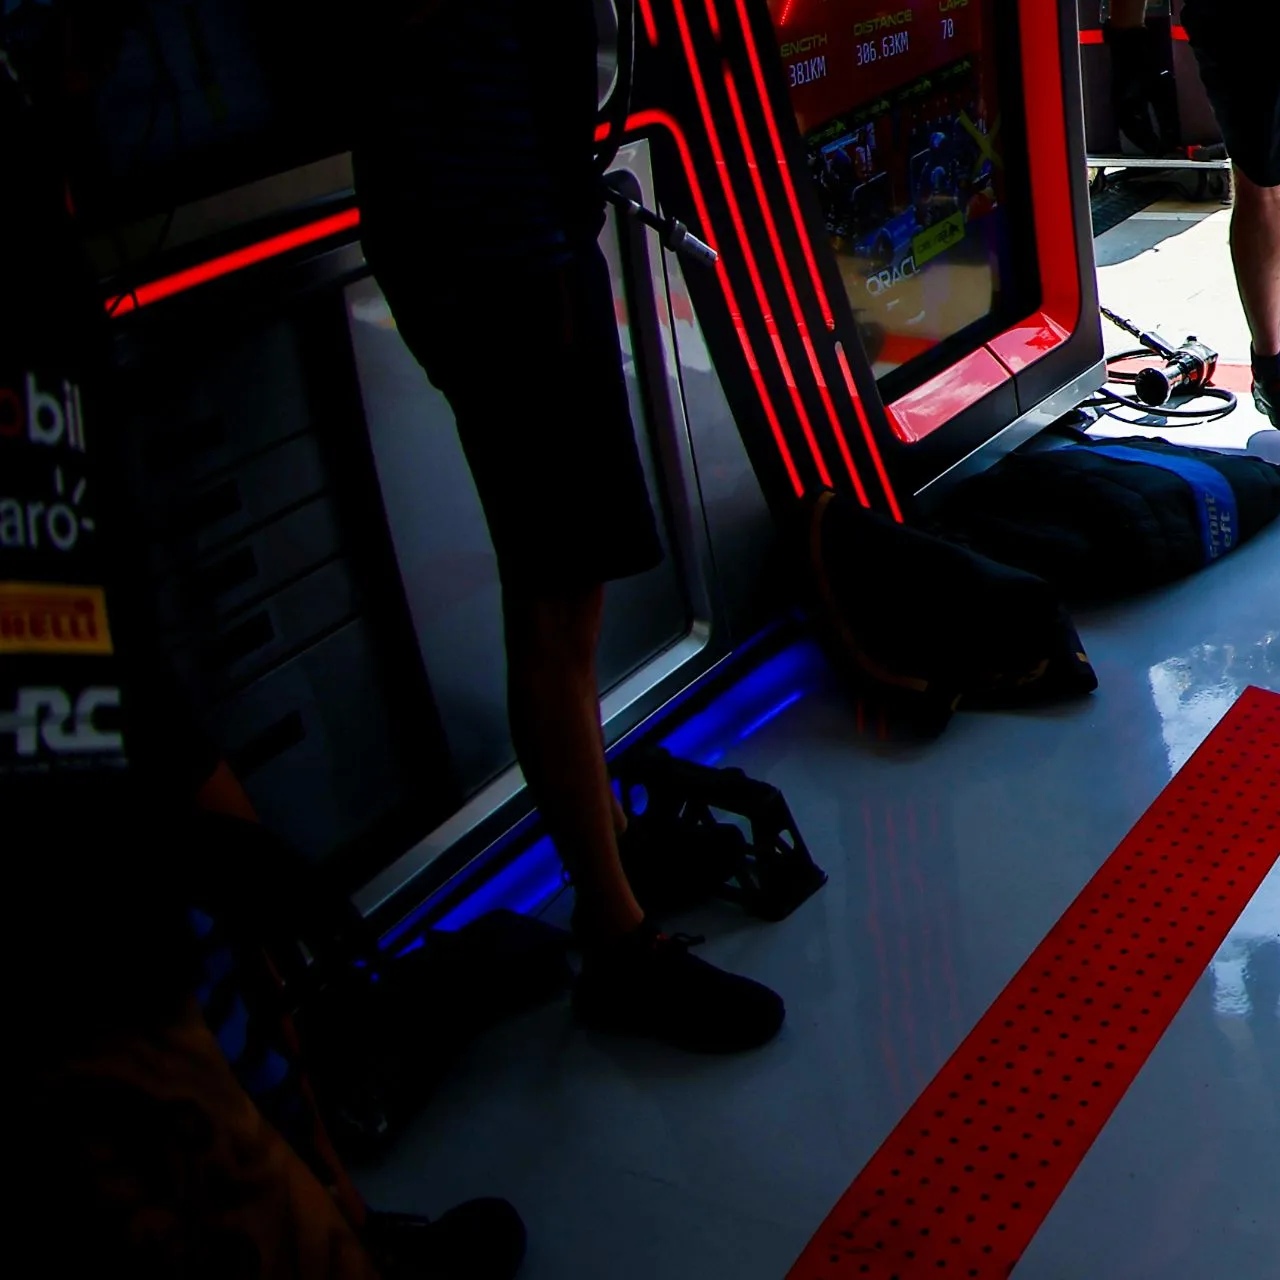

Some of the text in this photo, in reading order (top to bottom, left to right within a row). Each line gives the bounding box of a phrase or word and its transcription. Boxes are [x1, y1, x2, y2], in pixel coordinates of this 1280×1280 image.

[853, 8, 913, 37] DISTANCE
[940, 17, 954, 40] 70
[780, 32, 828, 58] ENGTH
[855, 30, 909, 67] 306.63KM
[788, 55, 827, 88] 381KM
[865, 254, 921, 296] ORACL
[0, 478, 88, 553] aro
[1204, 491, 1220, 559] Front
[1220, 511, 1232, 549] eft
